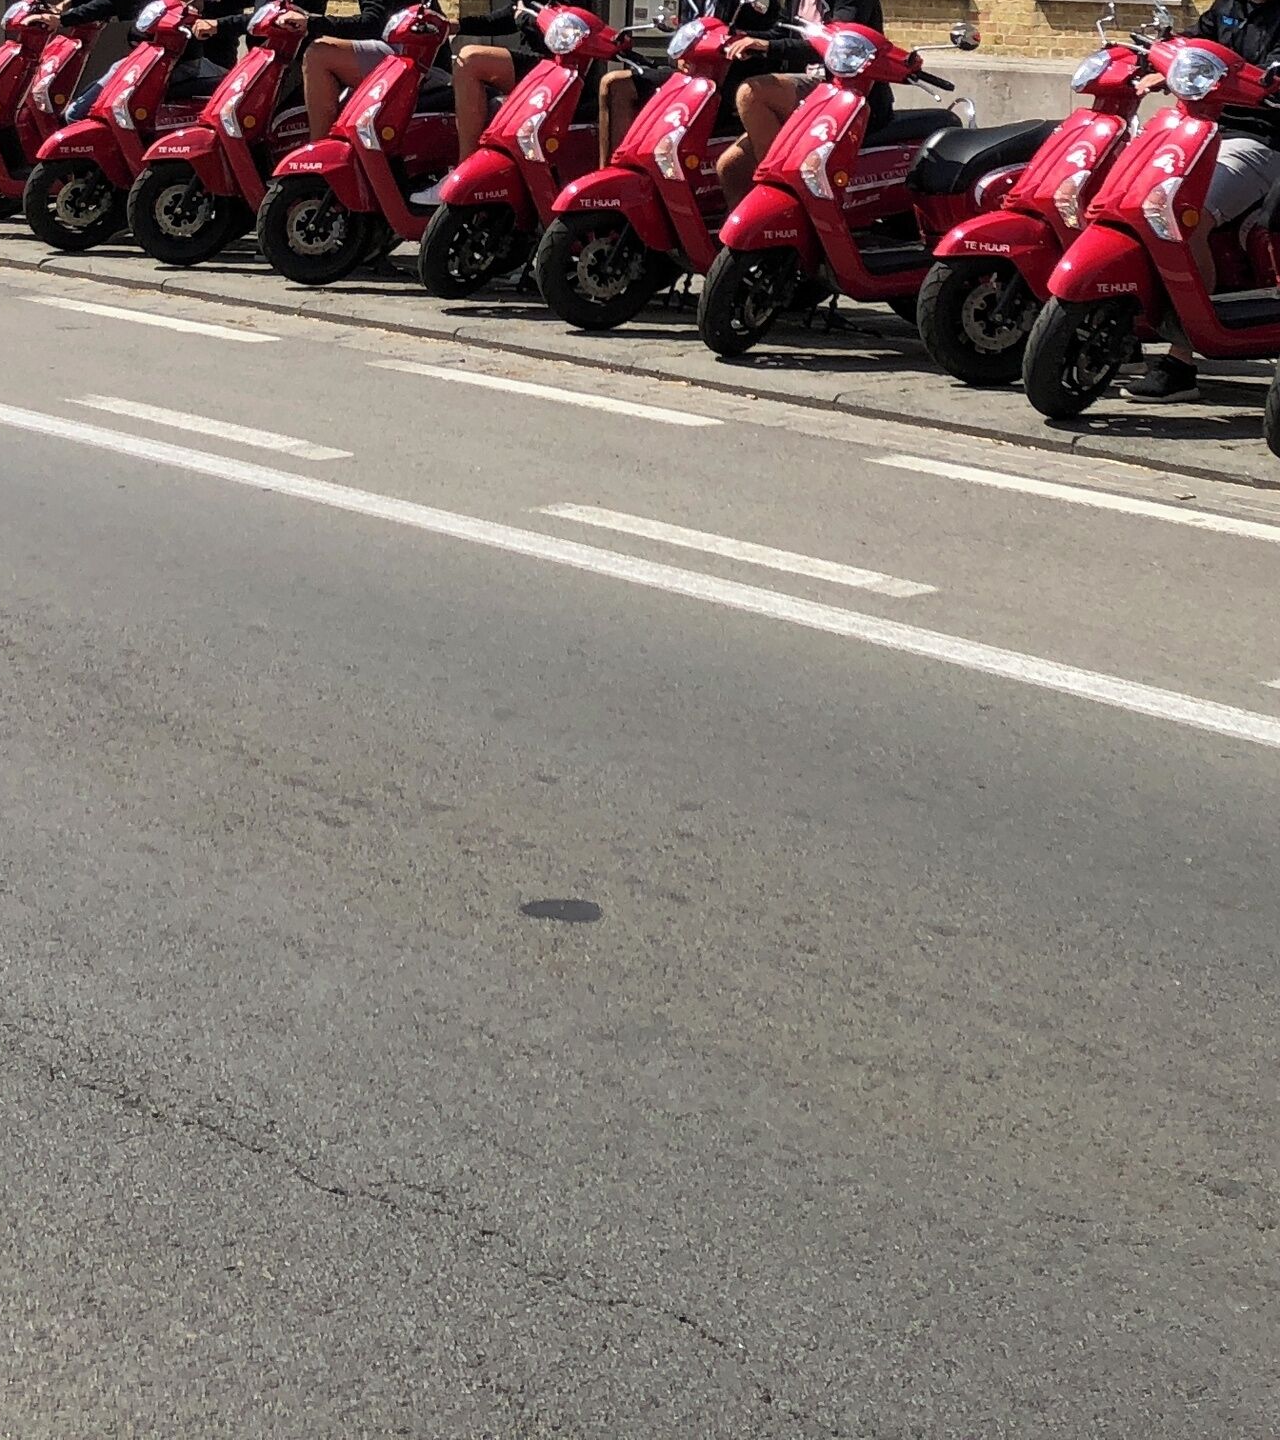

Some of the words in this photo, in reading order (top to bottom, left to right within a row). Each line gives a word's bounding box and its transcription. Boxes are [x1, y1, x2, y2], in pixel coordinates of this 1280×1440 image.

[963, 240, 977, 250] TE
[979, 242, 1010, 253] HUUR
[1096, 283, 1109, 293] TE
[1110, 282, 1138, 292] HUUR
